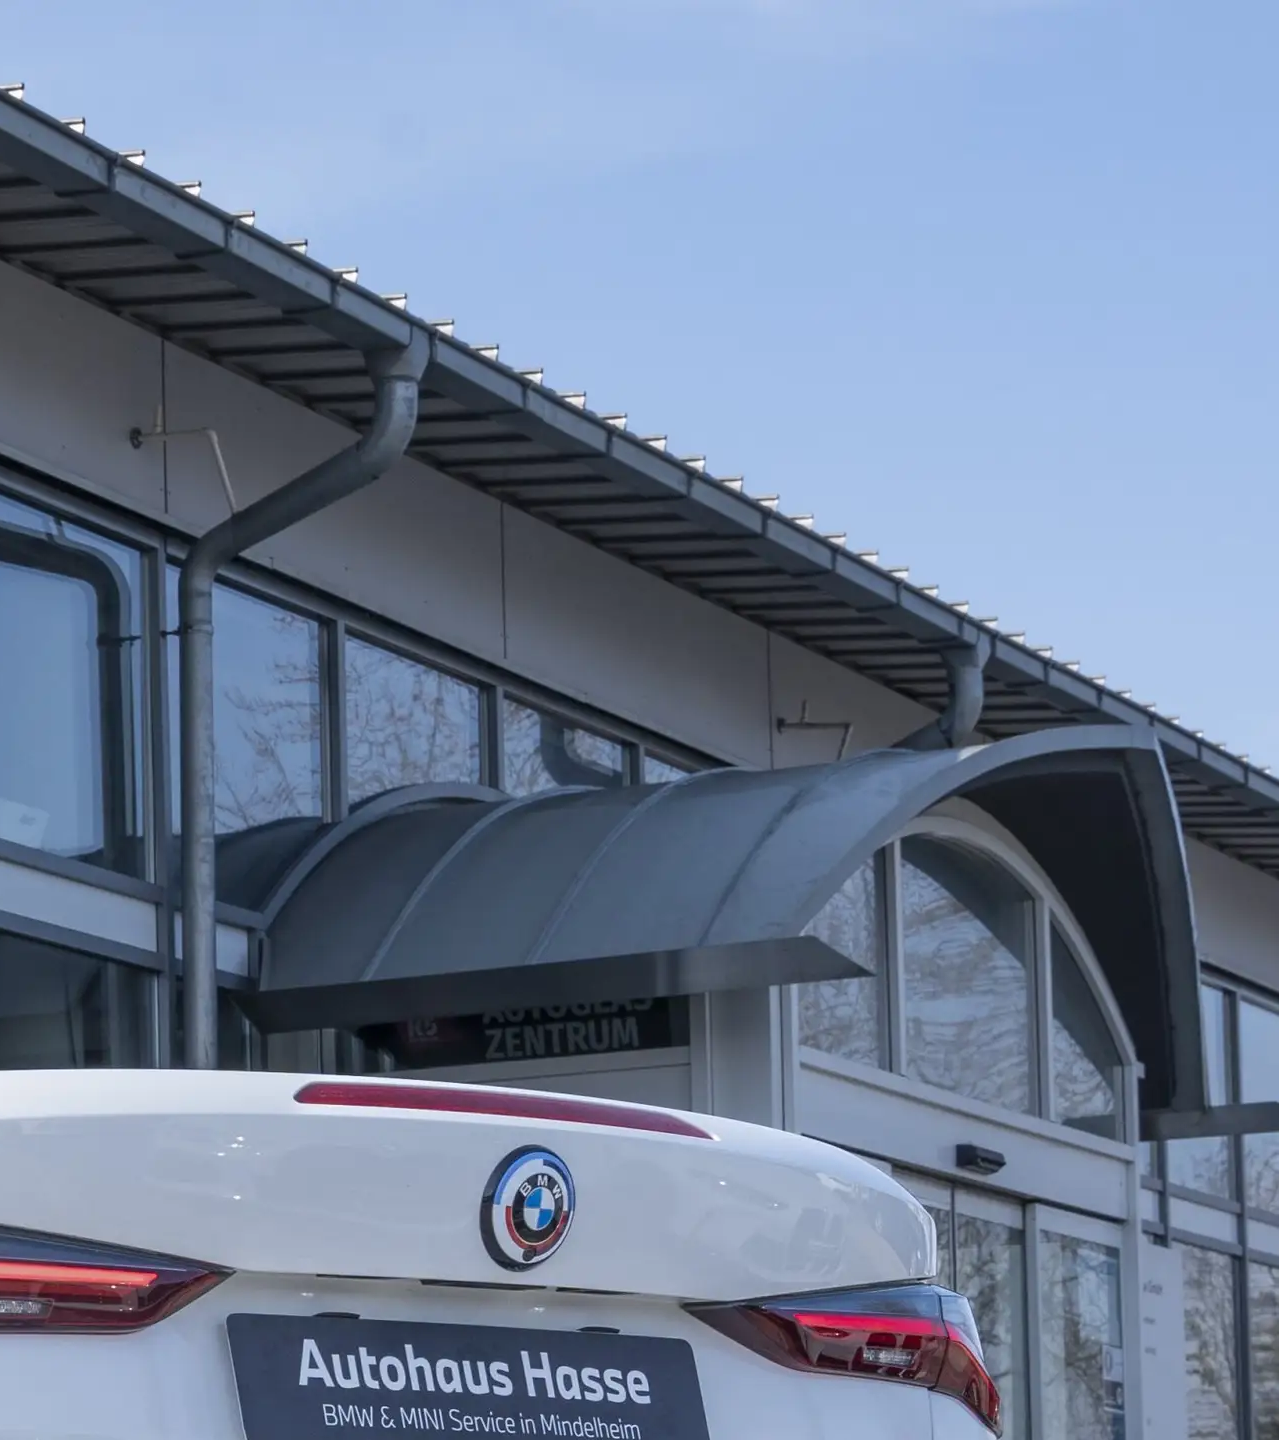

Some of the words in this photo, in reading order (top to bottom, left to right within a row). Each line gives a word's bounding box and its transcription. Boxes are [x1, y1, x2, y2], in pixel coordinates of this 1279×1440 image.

[485, 1017, 639, 1060] ZENTRUM
[519, 1174, 563, 1200] BMW
[298, 1338, 514, 1397] Autohaus
[520, 1350, 652, 1404] Hasse
[322, 1403, 374, 1428] BMW
[380, 1405, 396, 1428] &
[399, 1406, 445, 1431] MINI
[448, 1408, 516, 1434] Service
[519, 1412, 537, 1435] in
[540, 1413, 642, 1440] Mindelheim
